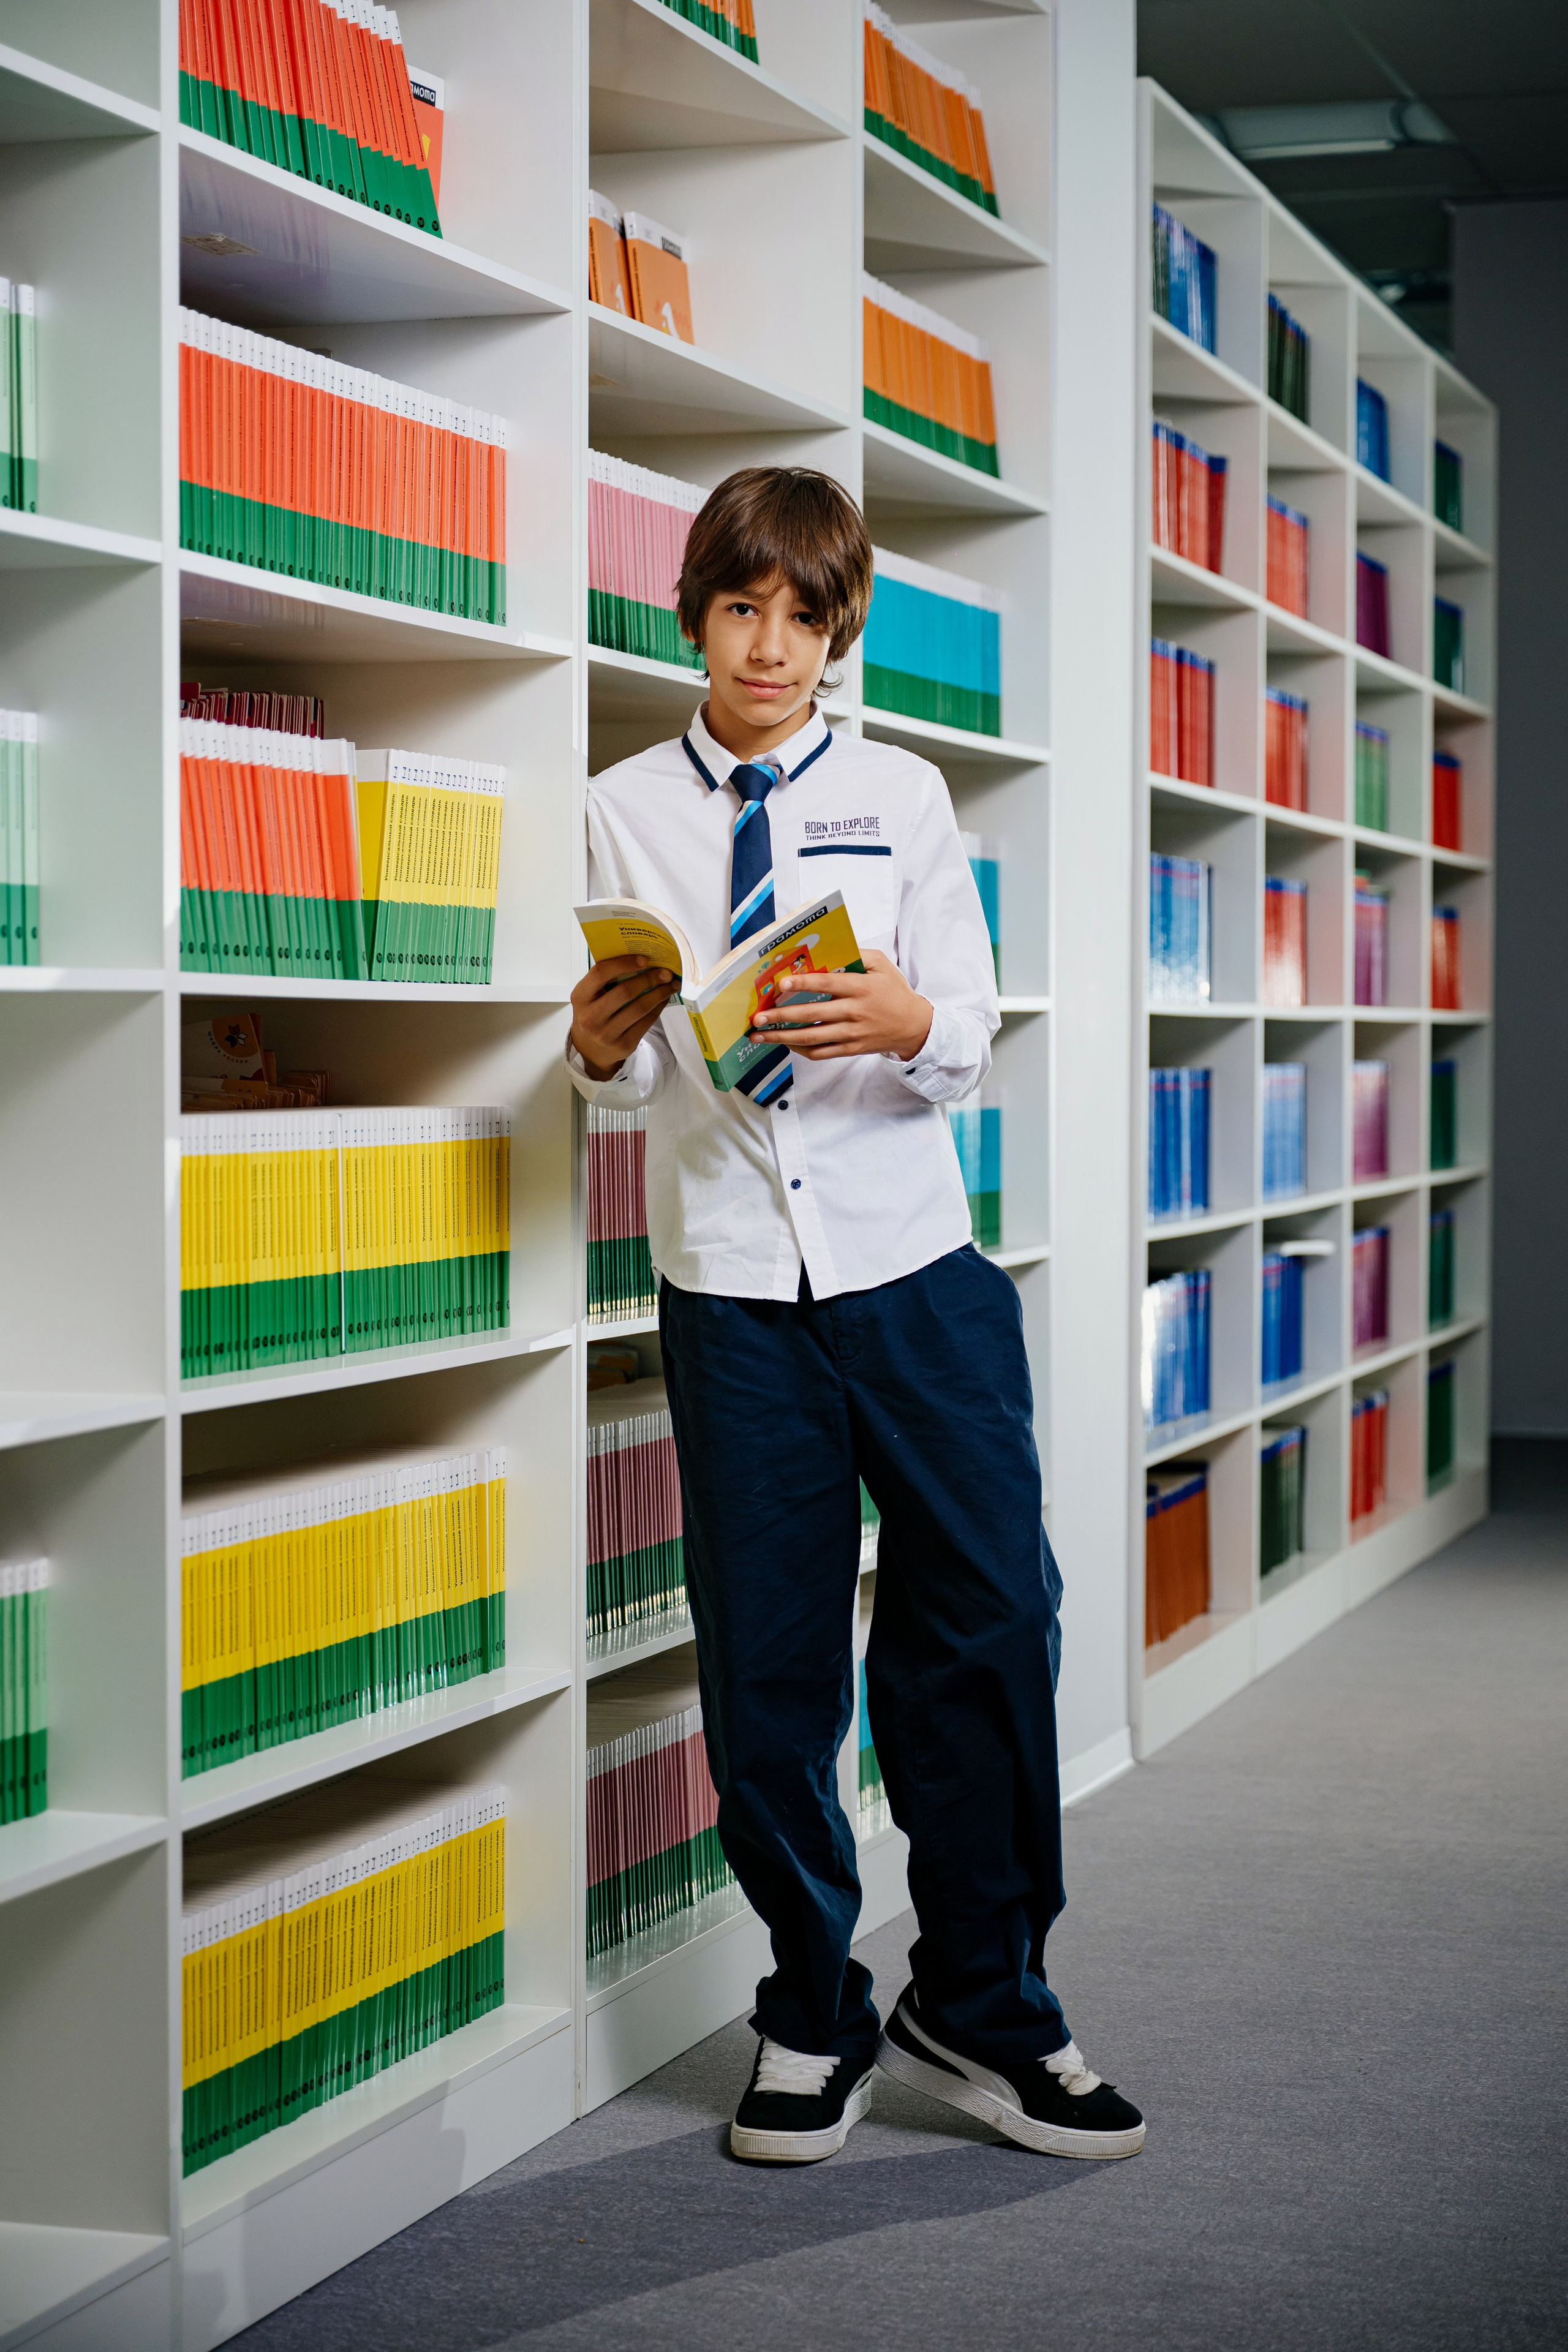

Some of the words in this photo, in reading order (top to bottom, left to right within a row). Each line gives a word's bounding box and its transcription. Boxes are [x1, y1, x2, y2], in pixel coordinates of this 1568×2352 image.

[410, 83, 435, 102] мота
[805, 821, 827, 833] BORN
[830, 822, 840, 832] TO
[843, 816, 880, 830] EXPLORE
[761, 908, 825, 954] грамота
[208, 1031, 221, 1054] ШКОЛА
[222, 1054, 248, 1064] РОССИИ
